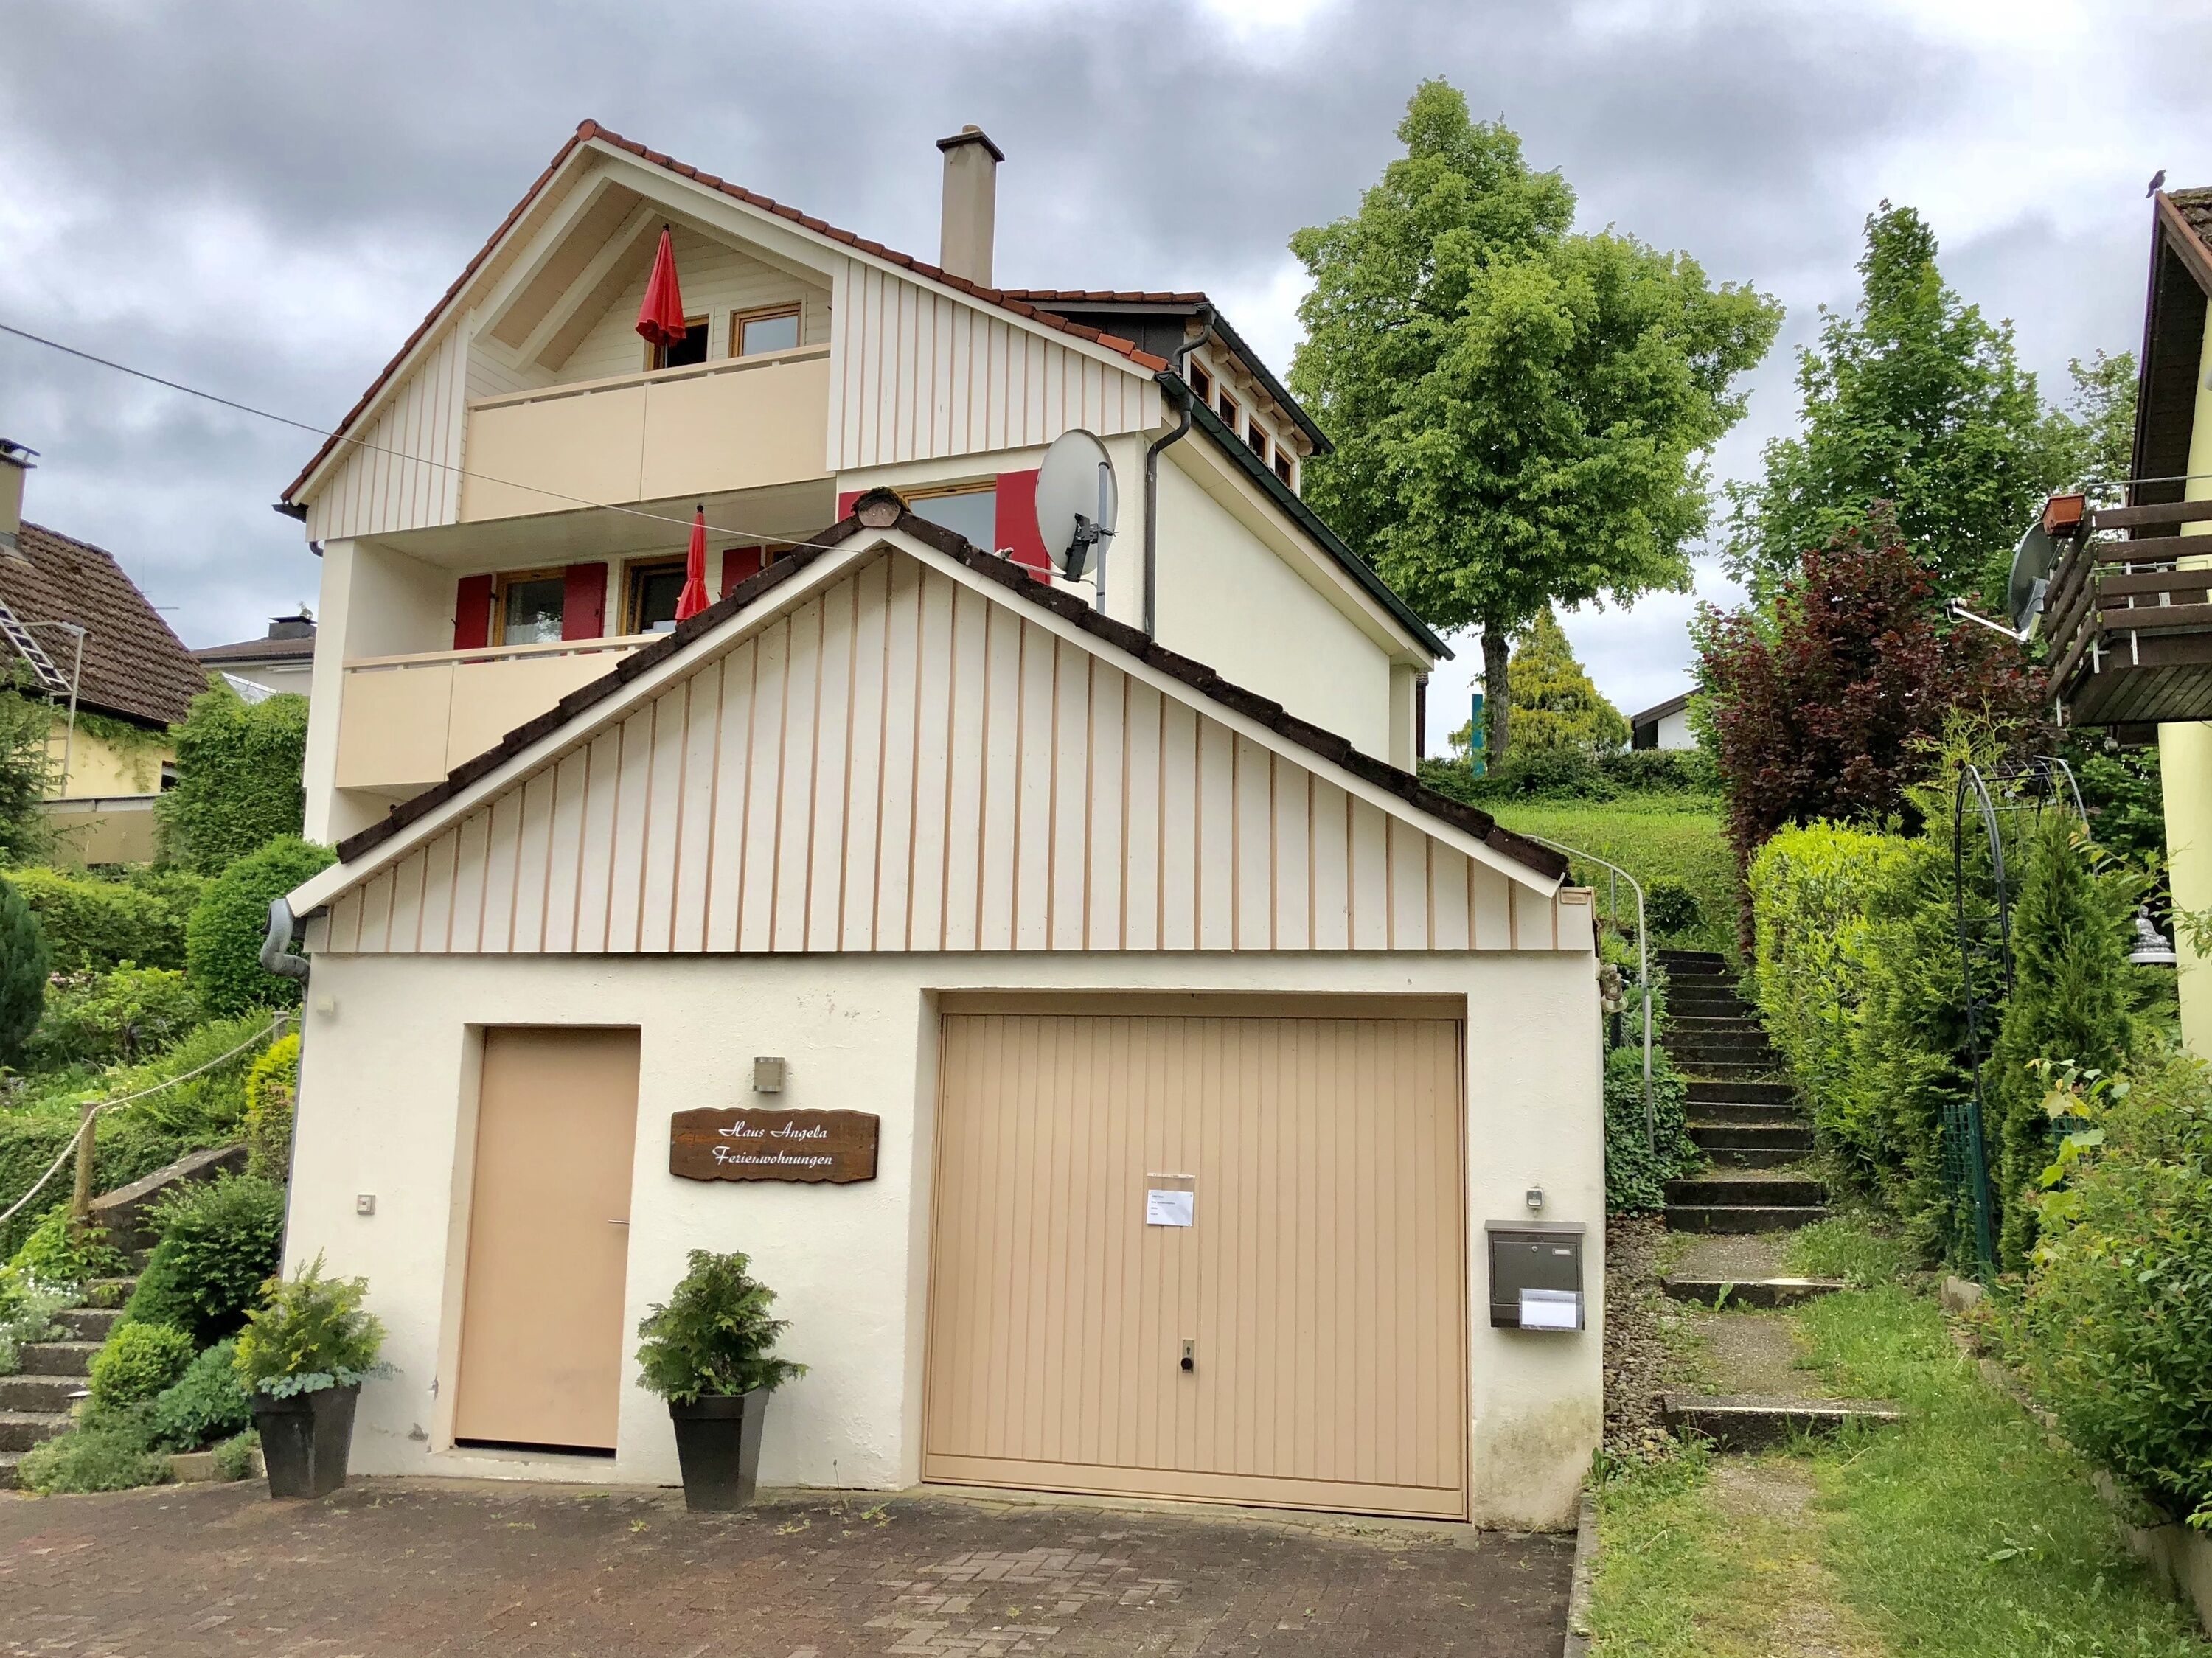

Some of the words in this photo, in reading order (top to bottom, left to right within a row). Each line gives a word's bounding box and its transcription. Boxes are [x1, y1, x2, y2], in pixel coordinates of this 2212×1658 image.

[718, 1121, 764, 1138] Haus
[770, 1121, 827, 1141] Angela
[712, 1146, 832, 1168] Ferienwohnungen
